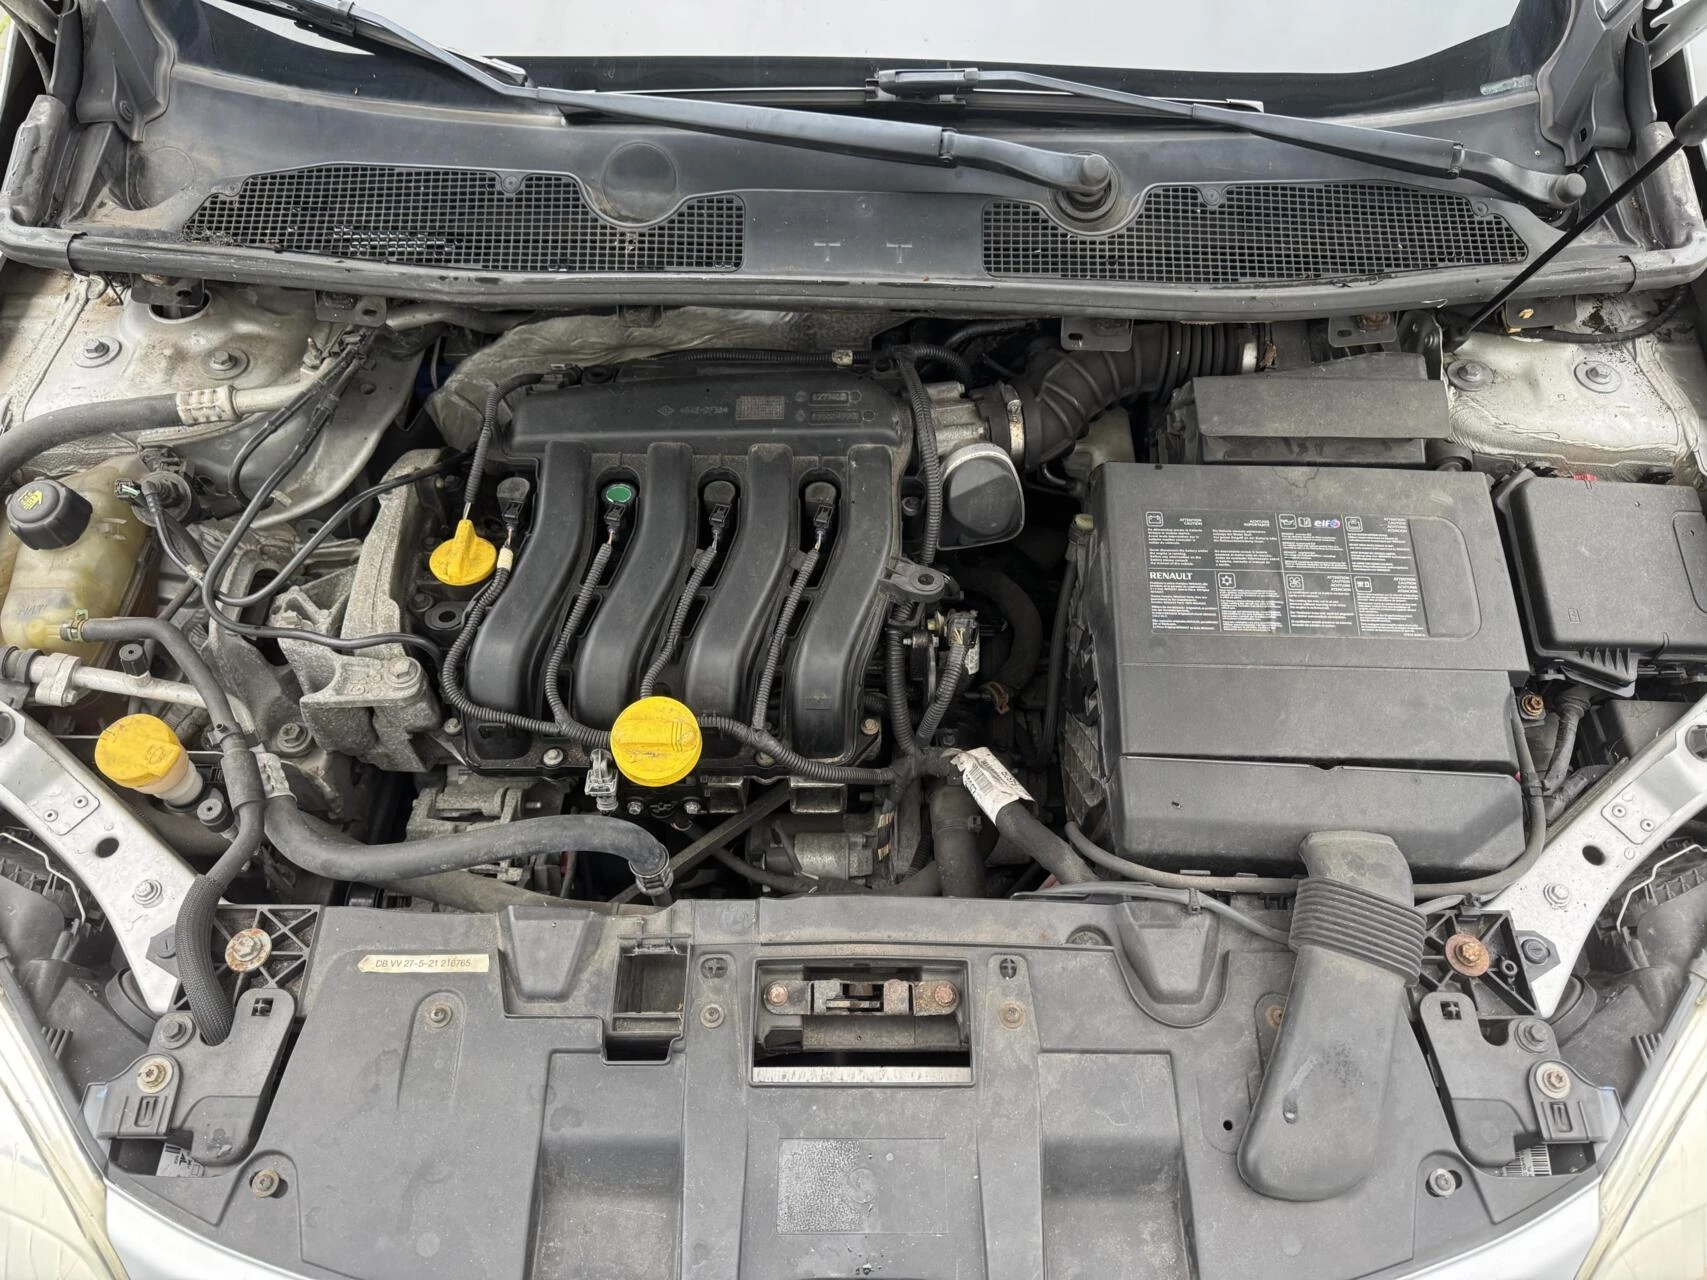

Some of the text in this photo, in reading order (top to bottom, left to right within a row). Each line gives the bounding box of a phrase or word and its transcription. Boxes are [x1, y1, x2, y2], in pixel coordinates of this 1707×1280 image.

[1314, 519, 1331, 527] elf
[1149, 571, 1193, 580] RENAULT
[375, 960, 388, 968] DB
[403, 959, 438, 968] 27-5-21
